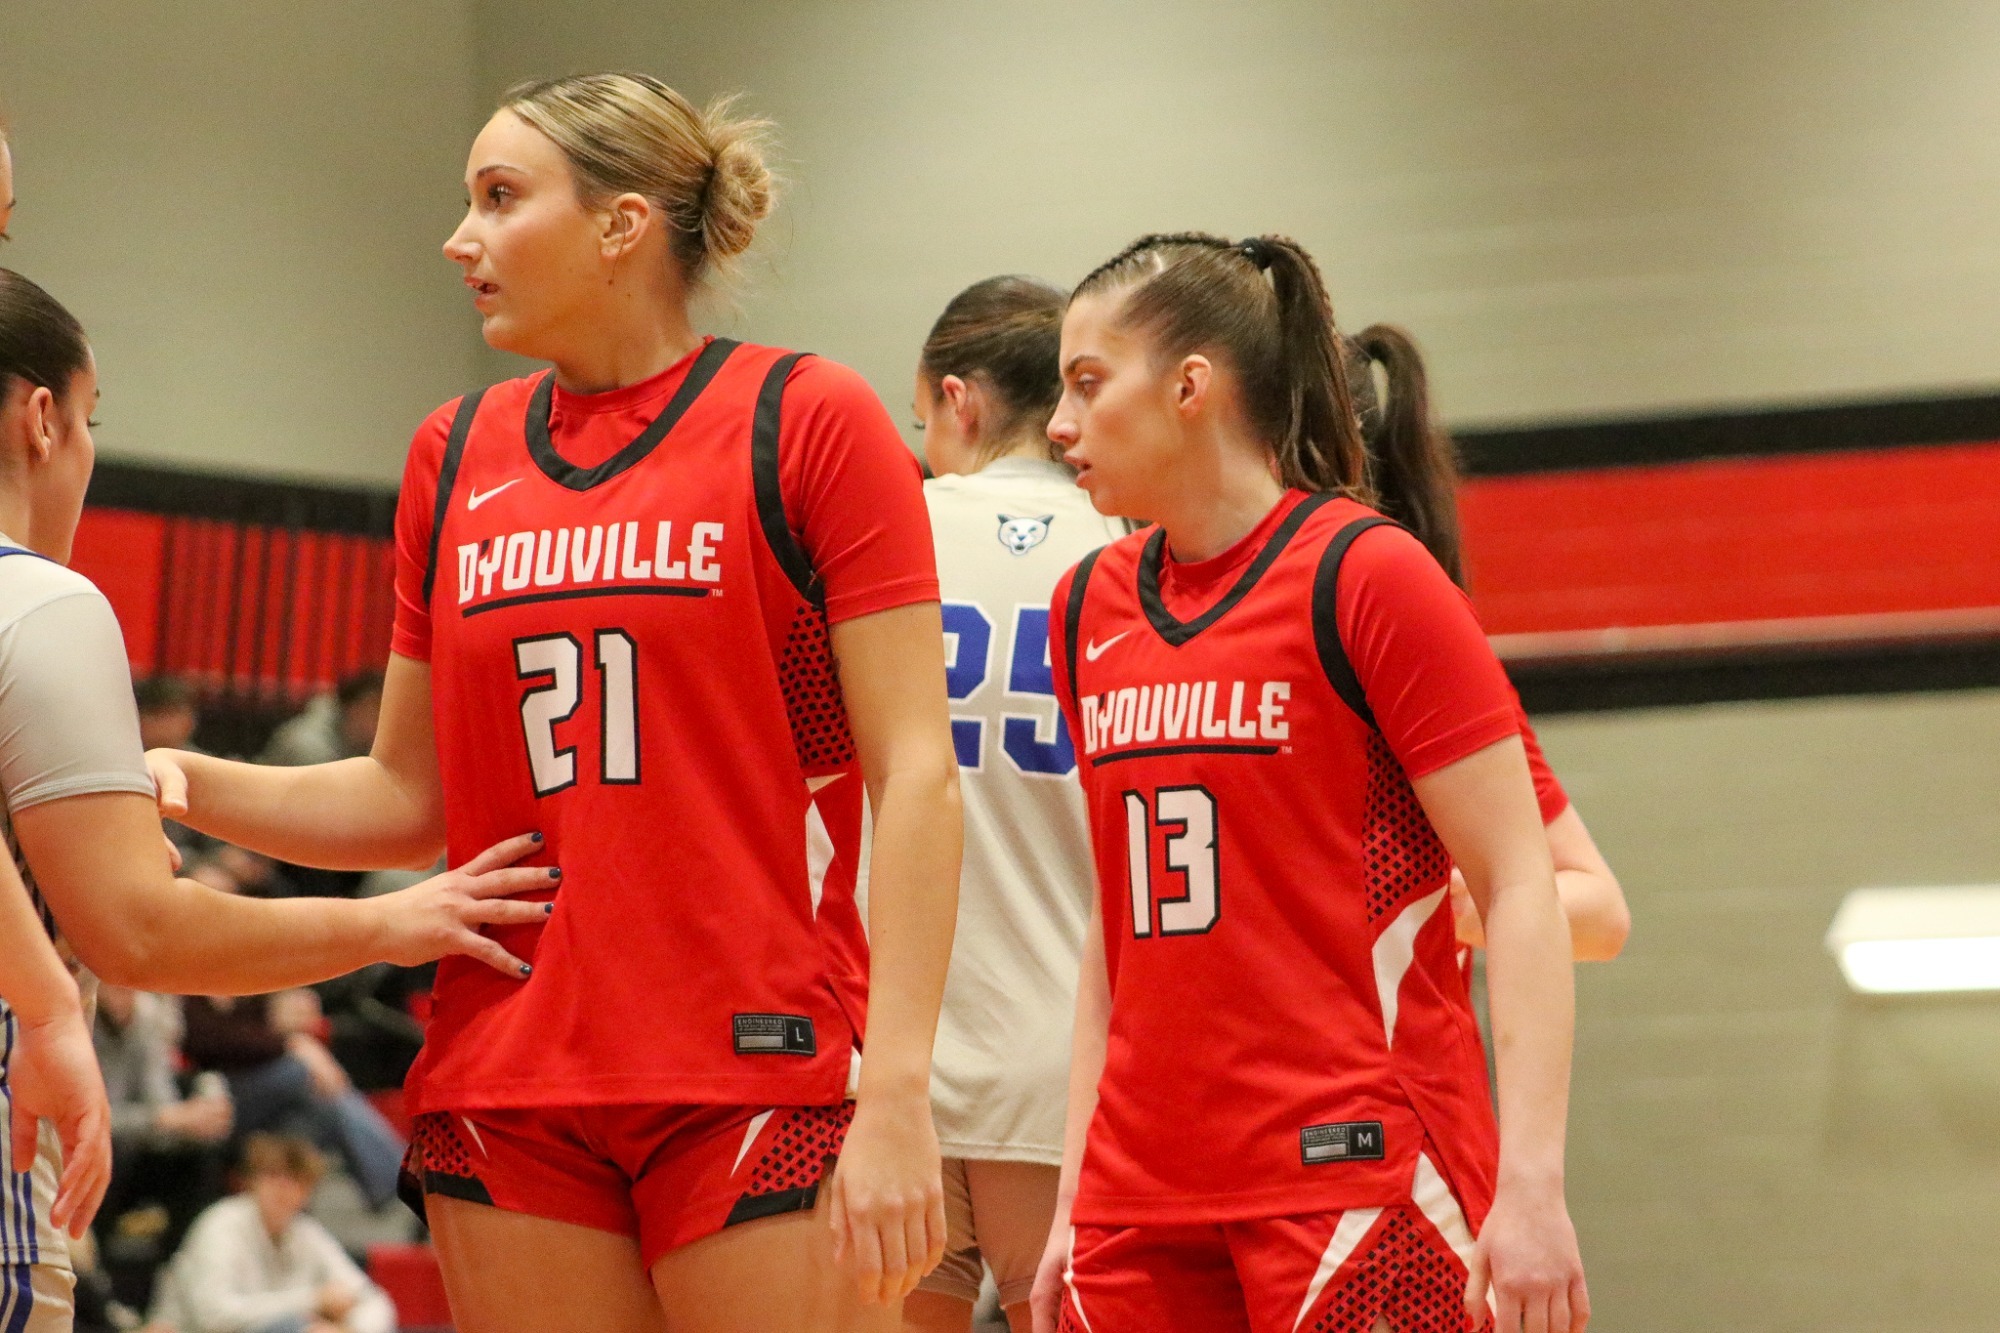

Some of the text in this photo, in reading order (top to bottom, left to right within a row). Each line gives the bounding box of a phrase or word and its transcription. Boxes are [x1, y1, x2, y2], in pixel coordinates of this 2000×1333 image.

[512, 627, 641, 799] 21
[1122, 784, 1221, 939] 13
[795, 1027, 804, 1042] L
[1357, 1132, 1372, 1148] M
